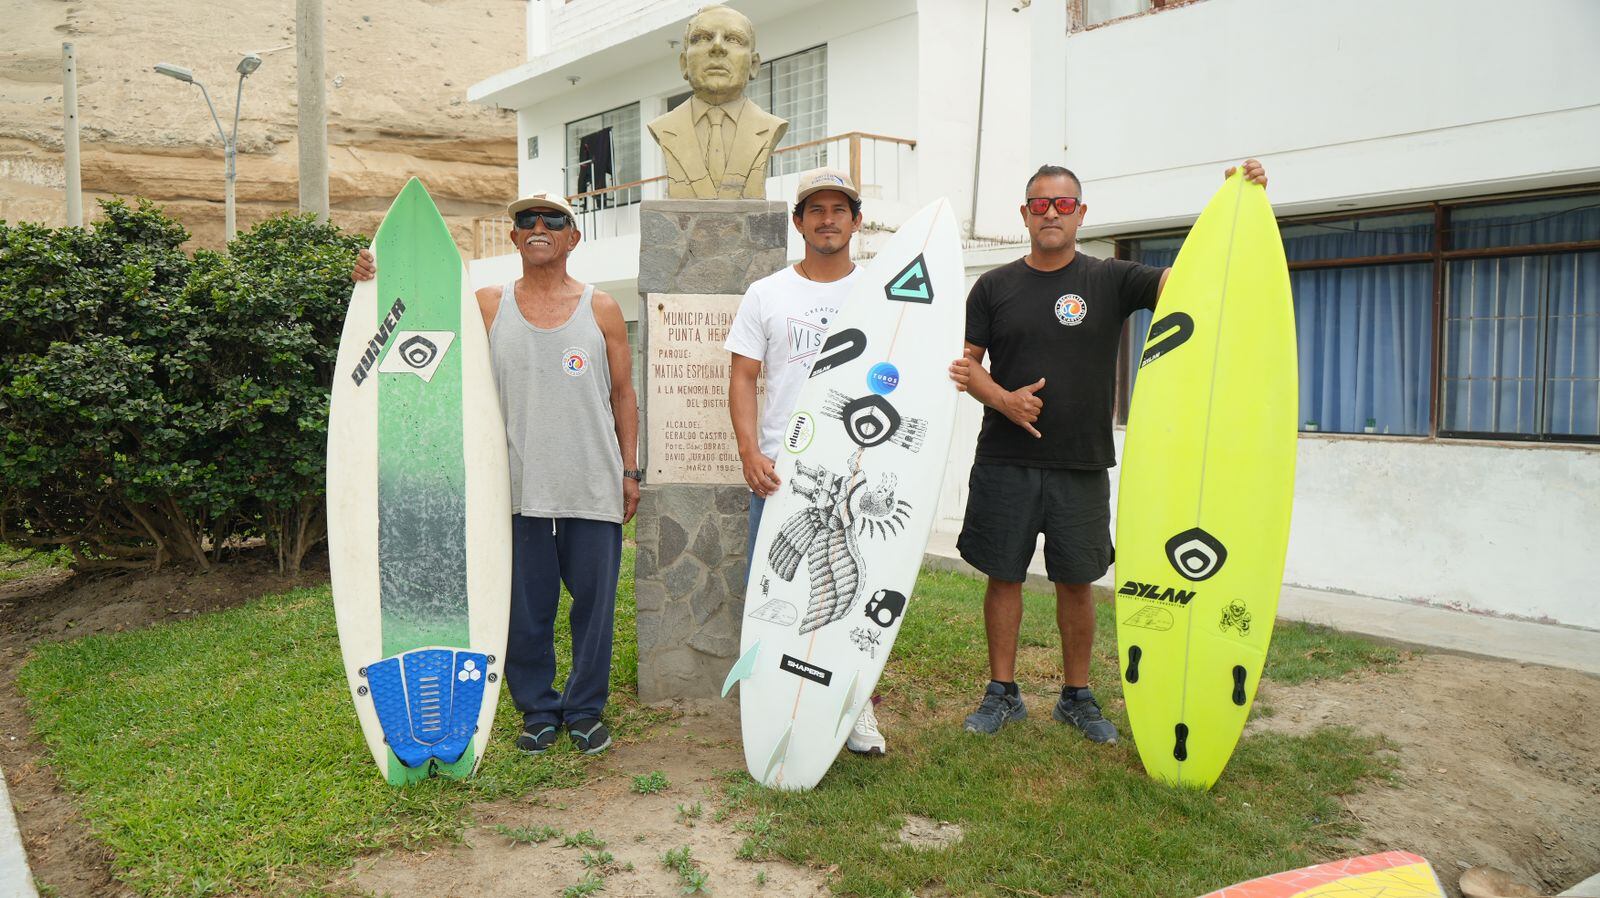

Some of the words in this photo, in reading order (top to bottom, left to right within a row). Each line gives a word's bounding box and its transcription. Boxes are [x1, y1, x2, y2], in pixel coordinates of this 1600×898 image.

[663, 312, 736, 326] MUNICIPALIDA
[351, 297, 406, 387] QUIVER
[668, 328, 702, 343] PUNTA
[708, 328, 730, 341] HER
[793, 326, 821, 352] VIS
[873, 373, 898, 384] TUBOS
[657, 386, 661, 395] A
[664, 386, 674, 395] LA
[711, 386, 725, 395] DEL
[686, 399, 700, 408] DEL
[703, 399, 730, 408] DISTRIT
[665, 432, 697, 440] GERALDO
[699, 432, 727, 440] CASTRO
[789, 416, 806, 449] Hampi
[665, 453, 685, 461] DAVID
[688, 453, 715, 462] JURADO
[1118, 581, 1197, 605] DYLAN
[787, 660, 826, 678] SHAPERS
